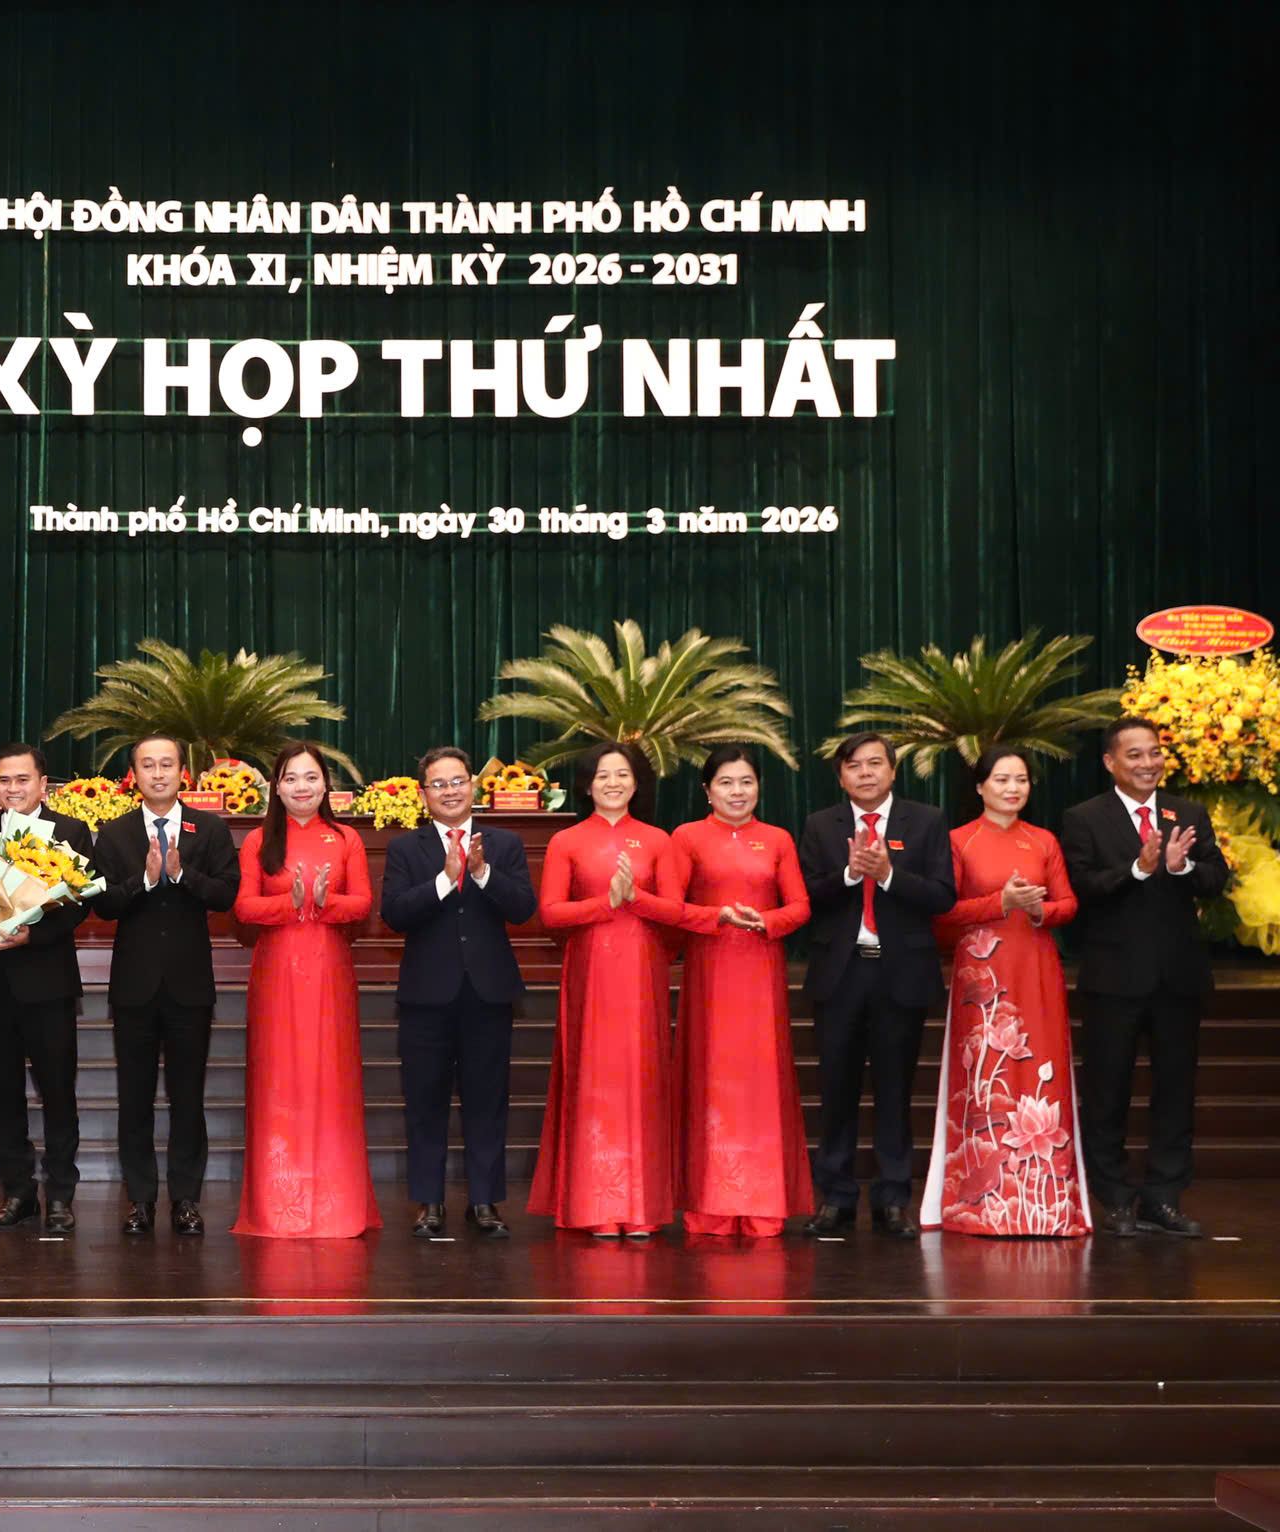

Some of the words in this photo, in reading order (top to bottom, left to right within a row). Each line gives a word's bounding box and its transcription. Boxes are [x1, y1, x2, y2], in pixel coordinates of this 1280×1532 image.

[71, 186, 183, 232] ĐỒNG
[195, 193, 300, 233] NHÂN
[311, 194, 389, 233] DÂN
[403, 193, 531, 234] THÀNH
[543, 186, 621, 233] PHỐ
[634, 186, 689, 232] HỒ
[701, 192, 762, 232] CHÍ
[772, 200, 866, 232] MINH
[127, 245, 236, 285] KHÓA
[246, 253, 302, 294] XI,
[313, 245, 433, 294] NHIỆM
[452, 243, 506, 285] KỲ
[529, 253, 623, 285] 2026
[652, 253, 737, 285] 2031
[143, 338, 359, 447] HỌP
[381, 314, 603, 418] THỨ
[622, 302, 896, 418] NHẤT
[29, 503, 120, 532] Thành
[128, 496, 186, 536] phố
[196, 498, 240, 532] Hồ
[249, 503, 301, 532] Chí
[310, 505, 391, 538] Minh,
[399, 504, 477, 539] ngày
[488, 507, 525, 533] 30
[539, 503, 629, 539] tháng
[643, 508, 668, 534] 3
[677, 506, 749, 533] năm
[760, 506, 839, 533] 2026
